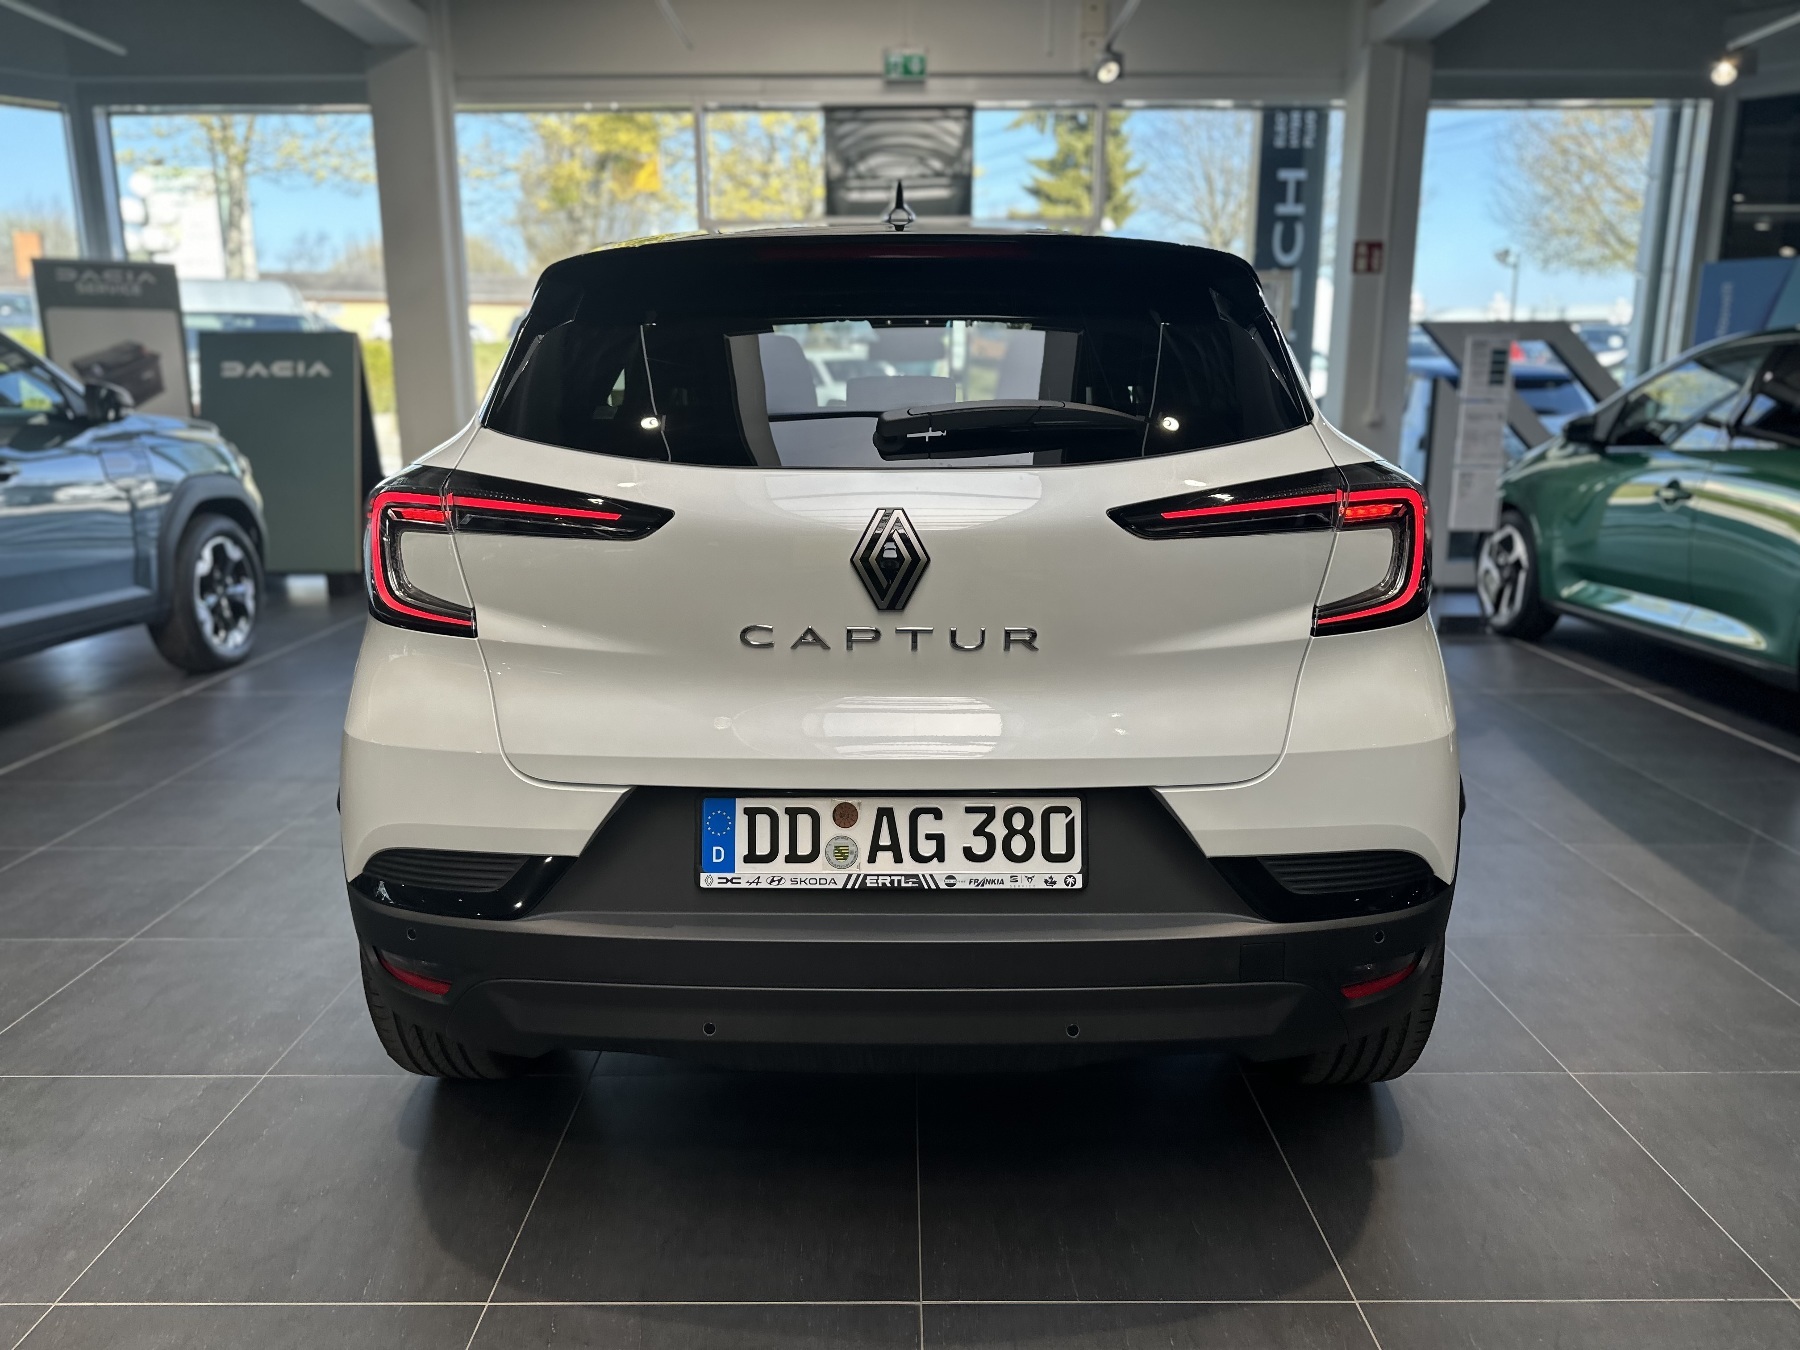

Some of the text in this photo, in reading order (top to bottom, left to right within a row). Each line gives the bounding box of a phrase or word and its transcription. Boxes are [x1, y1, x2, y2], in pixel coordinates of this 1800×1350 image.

[55, 266, 157, 284] DACIA
[220, 360, 331, 378] DACIA
[739, 624, 1039, 652] CAPTUR
[743, 806, 821, 864] DD
[867, 806, 945, 864] AG
[962, 805, 1075, 864] 380
[712, 846, 725, 863] D
[968, 877, 1005, 887] FRANKIA
